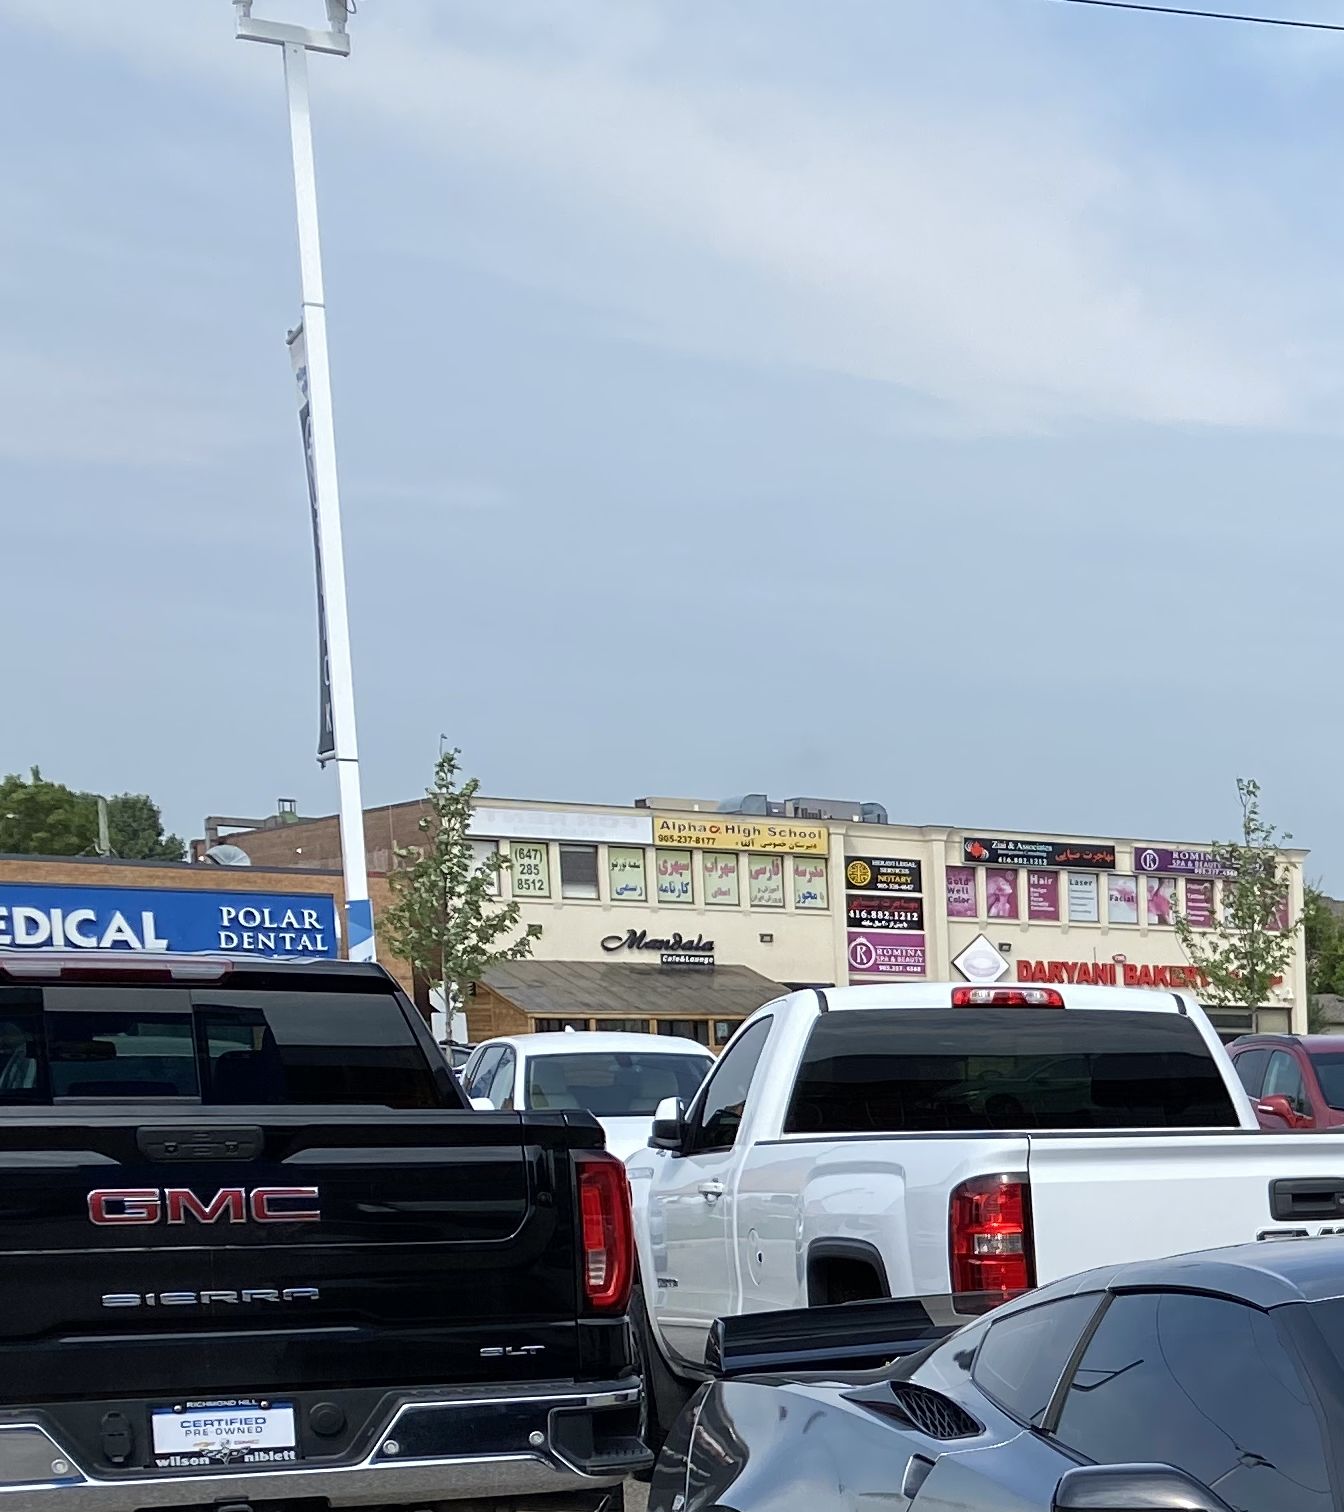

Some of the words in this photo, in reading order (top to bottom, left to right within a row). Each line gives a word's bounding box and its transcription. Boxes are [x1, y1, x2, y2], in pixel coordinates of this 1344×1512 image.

[660, 820, 707, 833] Alpha
[725, 825, 761, 839] High
[768, 826, 822, 840] School
[515, 848, 543, 863] (647)
[519, 863, 540, 876] 285
[1172, 859, 1186, 867] SPA
[517, 879, 544, 891] 8512
[877, 875, 912, 884] NOTARY
[1030, 874, 1053, 885] Hair
[1109, 894, 1134, 902] Facial
[219, 906, 324, 930] POLAR
[849, 909, 918, 921] 416.882.1212
[218, 931, 329, 952] DENTAL
[877, 948, 923, 957] ROMINA
[1016, 960, 1116, 985] DARYANI
[86, 1186, 321, 1226] GMC
[101, 1286, 320, 1308] SIERRA
[480, 1344, 547, 1357] SLT
[186, 1399, 236, 1408] RICHMOND
[180, 1416, 267, 1429] CERTIFIED
[155, 1455, 210, 1468] wilson
[244, 1450, 296, 1463] niblett
